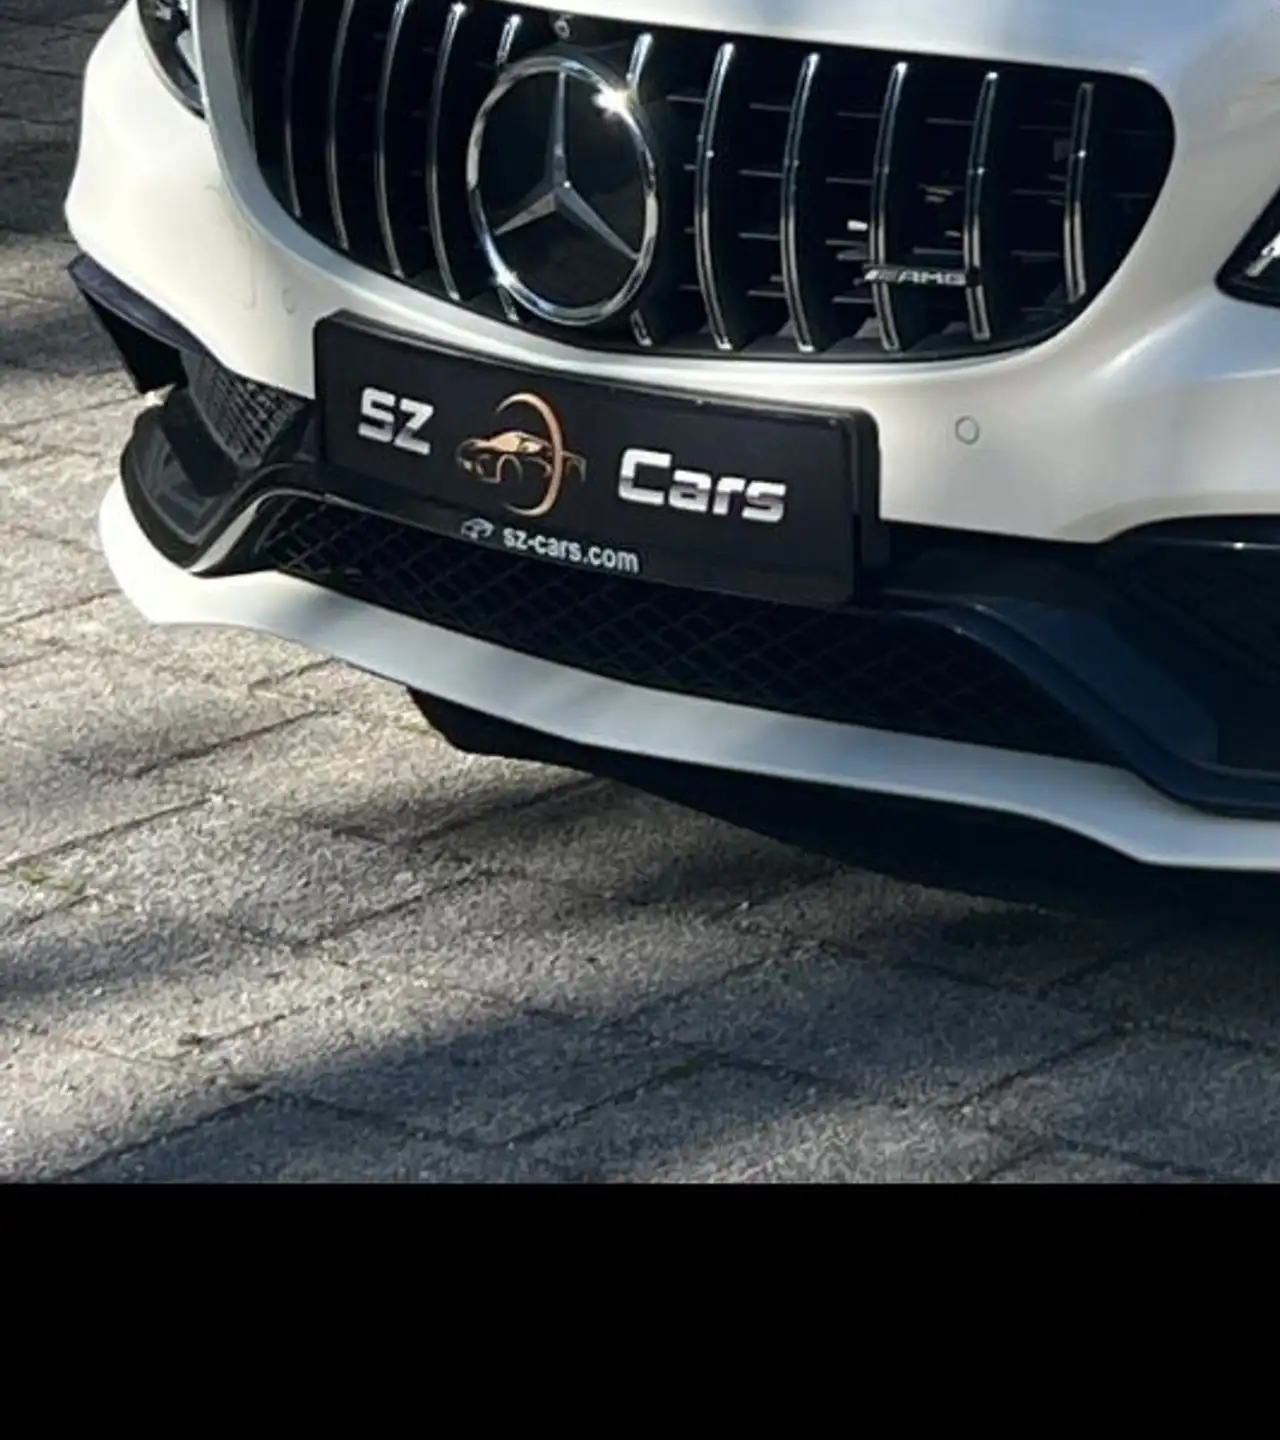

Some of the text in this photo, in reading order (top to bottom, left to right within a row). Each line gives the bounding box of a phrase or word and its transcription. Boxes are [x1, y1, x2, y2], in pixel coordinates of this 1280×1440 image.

[358, 388, 787, 523] SZ Cars
[502, 527, 639, 573] sz-cars.com
